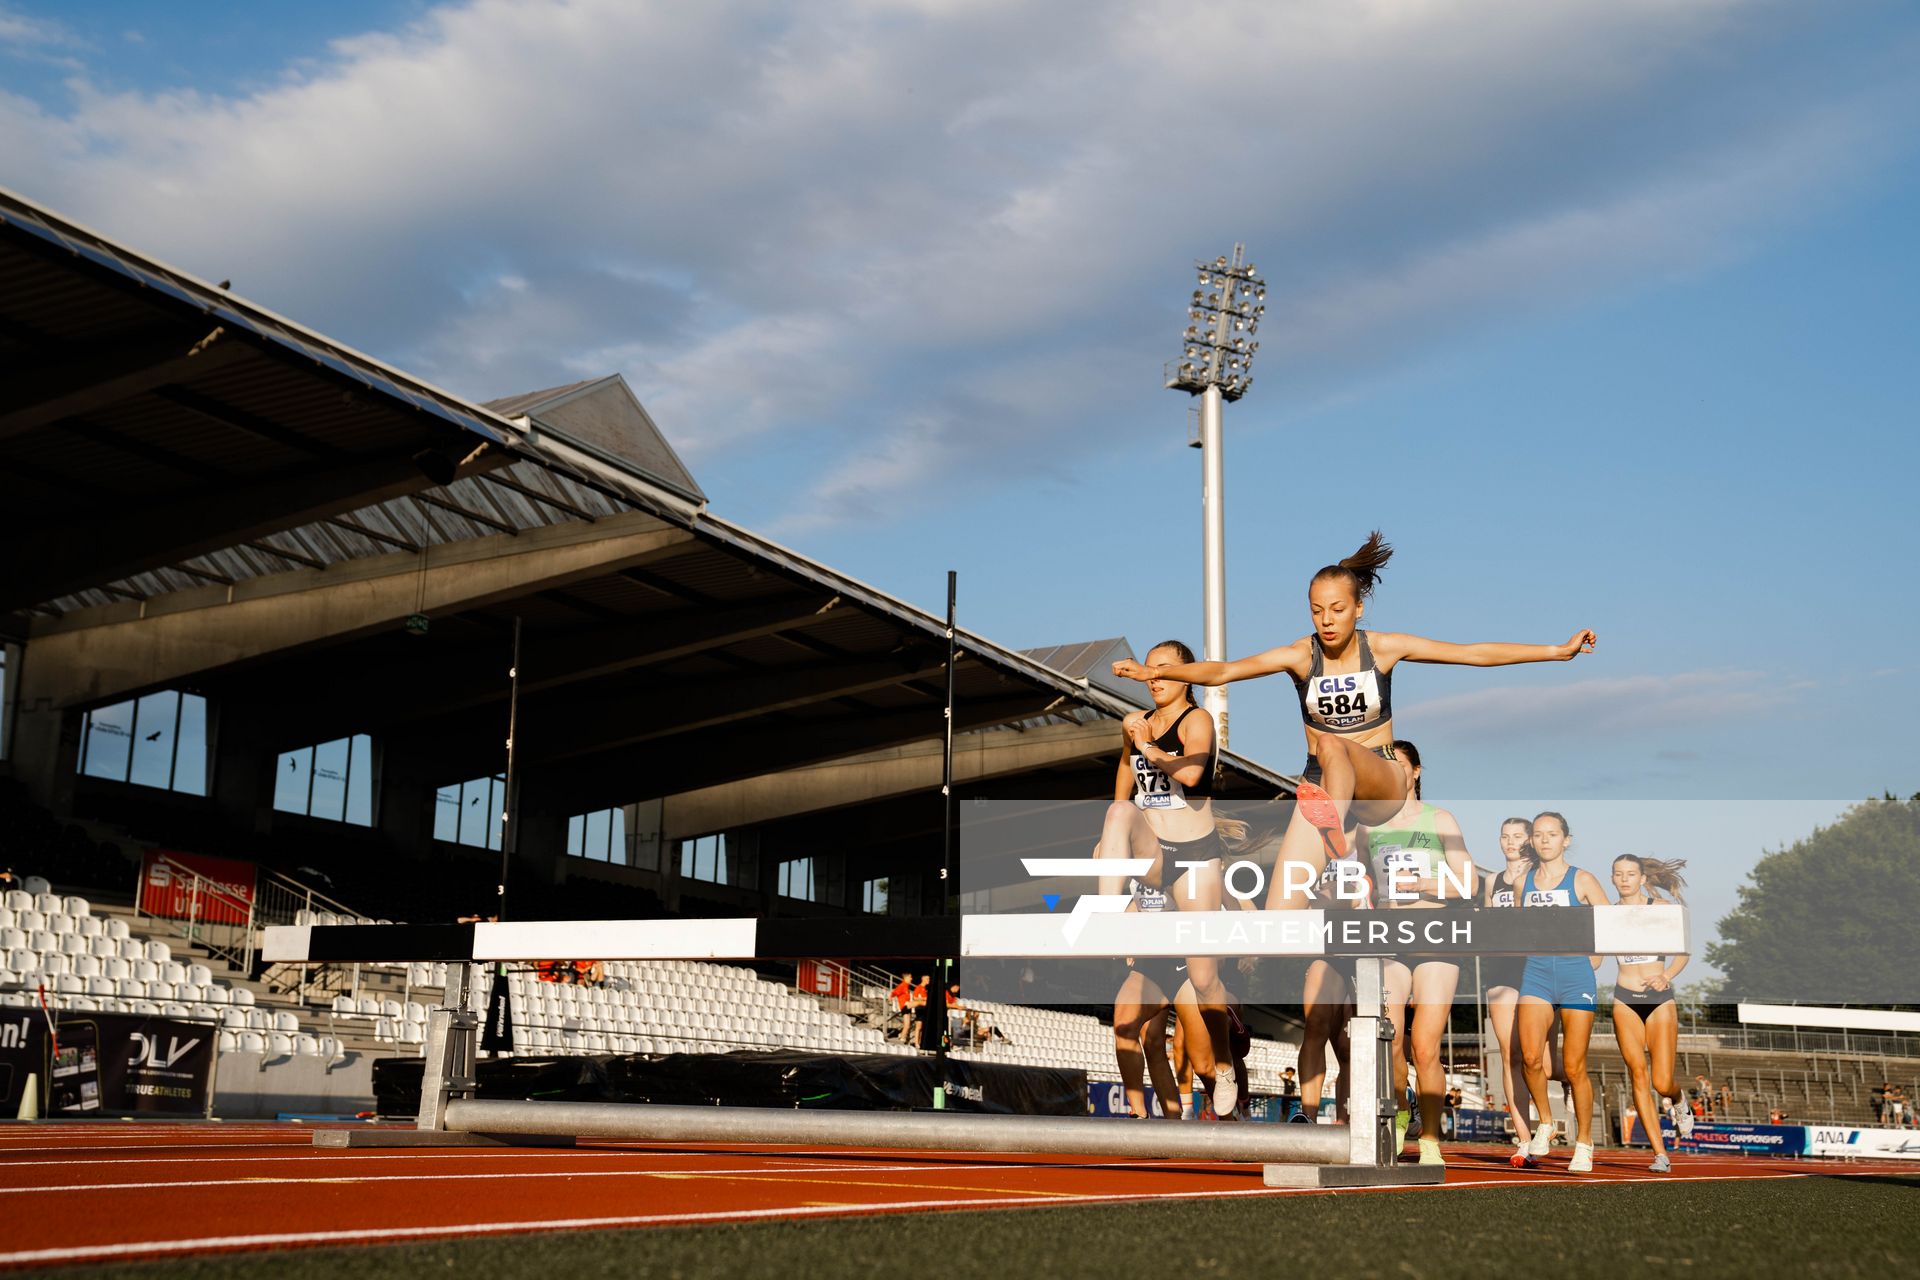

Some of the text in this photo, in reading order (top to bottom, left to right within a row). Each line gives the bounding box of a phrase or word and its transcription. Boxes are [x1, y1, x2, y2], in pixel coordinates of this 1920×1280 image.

[945, 627, 954, 639] 6
[508, 667, 517, 678] 6
[1318, 676, 1357, 694] GLS
[1317, 692, 1368, 716] 584
[1136, 771, 1171, 793] 873
[941, 785, 950, 796] 4
[940, 868, 947, 879] 3
[497, 885, 505, 896] 3
[1530, 893, 1554, 903] GLS
[0, 1017, 31, 1049] n!
[127, 1032, 200, 1068] DLV
[1815, 1131, 1845, 1144] ANA
